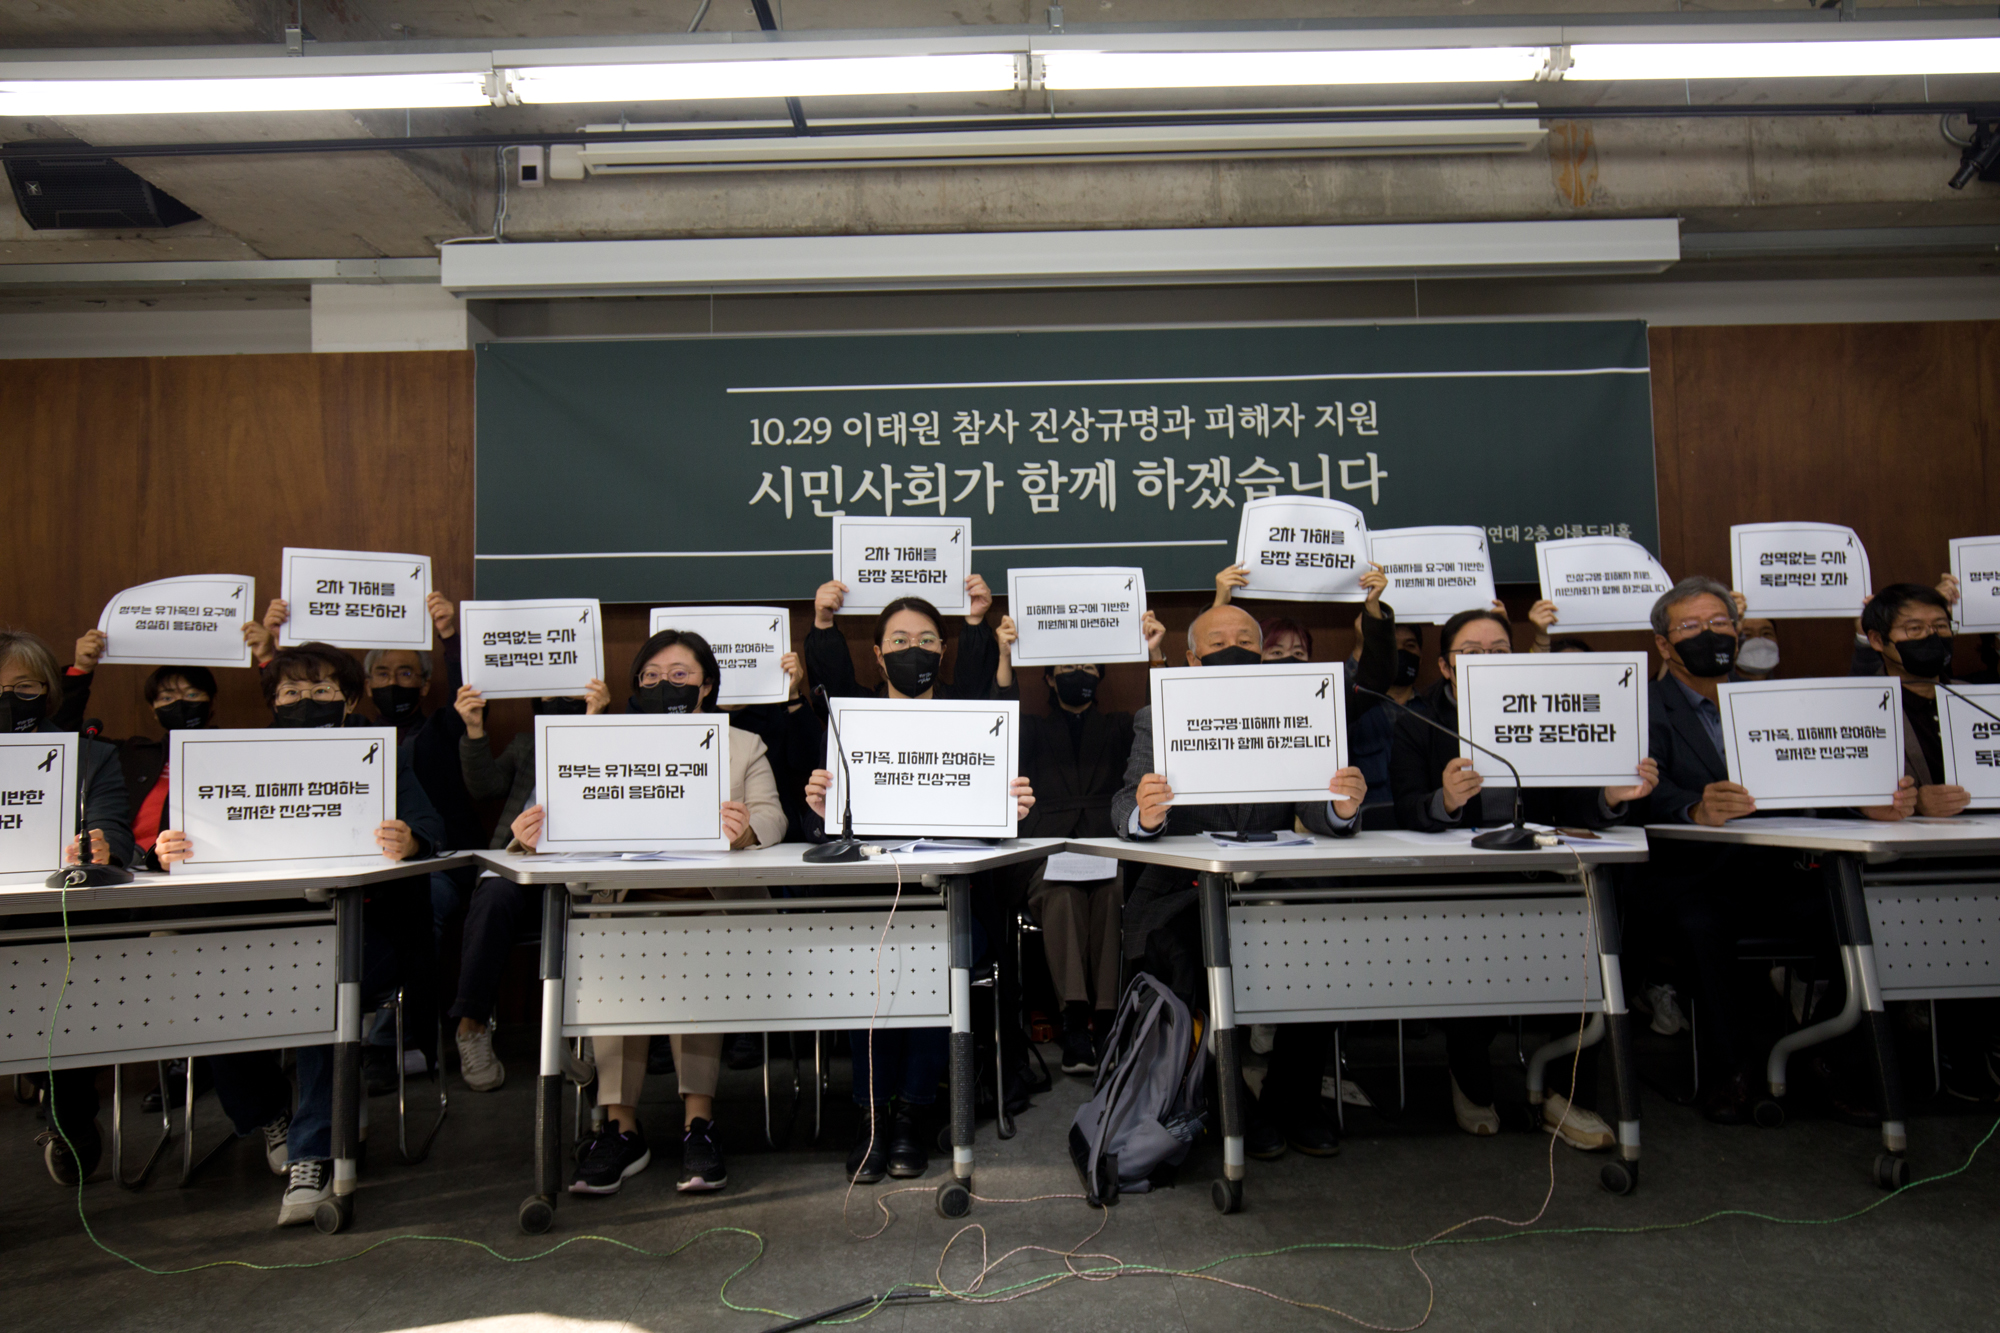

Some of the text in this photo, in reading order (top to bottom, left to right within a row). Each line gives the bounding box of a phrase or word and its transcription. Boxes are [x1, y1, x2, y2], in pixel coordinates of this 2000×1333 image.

[751, 401, 1378, 447] 10.29 이태원 참사 진상규명과 피해자 지원
[749, 453, 1387, 519] 시민사회가 함께 하겠습니다
[1269, 527, 1344, 544] 2차 가해를
[1482, 525, 1520, 543] 연대
[1524, 524, 1550, 542] 2층
[865, 547, 936, 561] 2차 가해를
[1261, 551, 1355, 569] 당장 중단하라
[1760, 552, 1846, 565] 성역없는 수사
[1383, 562, 1484, 574] 피해자들 요구에 기반한
[858, 570, 947, 583] 당장 중단하라
[1395, 577, 1476, 588] 지원체계 마련하라
[1761, 573, 1848, 587] 독립적인 조사
[317, 580, 394, 596] 2차 가해를
[1555, 584, 1666, 596] 시민사회가 함께 하겠습니다
[119, 606, 236, 617] 정부는 유가족의 요구에
[309, 602, 406, 618] 당장 중단하라
[1027, 602, 1129, 615] 피해자들 요구에 기반한
[136, 620, 218, 631] 성실히 응답하라
[1038, 618, 1119, 630] 지원체계 마련하라
[483, 629, 576, 645] 성역없는 수사
[710, 643, 774, 653] 해자 참여하는
[485, 651, 577, 667] 독립적인 조사
[1503, 694, 1600, 713] 2차 가해를
[1495, 724, 1616, 743] 당장 중단하라
[1797, 727, 1837, 740] 피해자
[1840, 726, 1886, 739] 참여하는
[1171, 735, 1331, 751] 시민사회가 함께 하겠습니다
[898, 752, 938, 764] 피해자
[942, 752, 995, 765] 참여하는
[1775, 746, 1868, 761] 철저한 진상규명
[559, 763, 707, 778] 정부는 유가족의 요구에
[874, 772, 970, 786] 철저한 진상규명
[256, 783, 304, 797] 피해자
[308, 781, 369, 795] 참여하는
[583, 785, 685, 799] 성실히 응답하라
[227, 803, 341, 820] 철저한 진상규명
